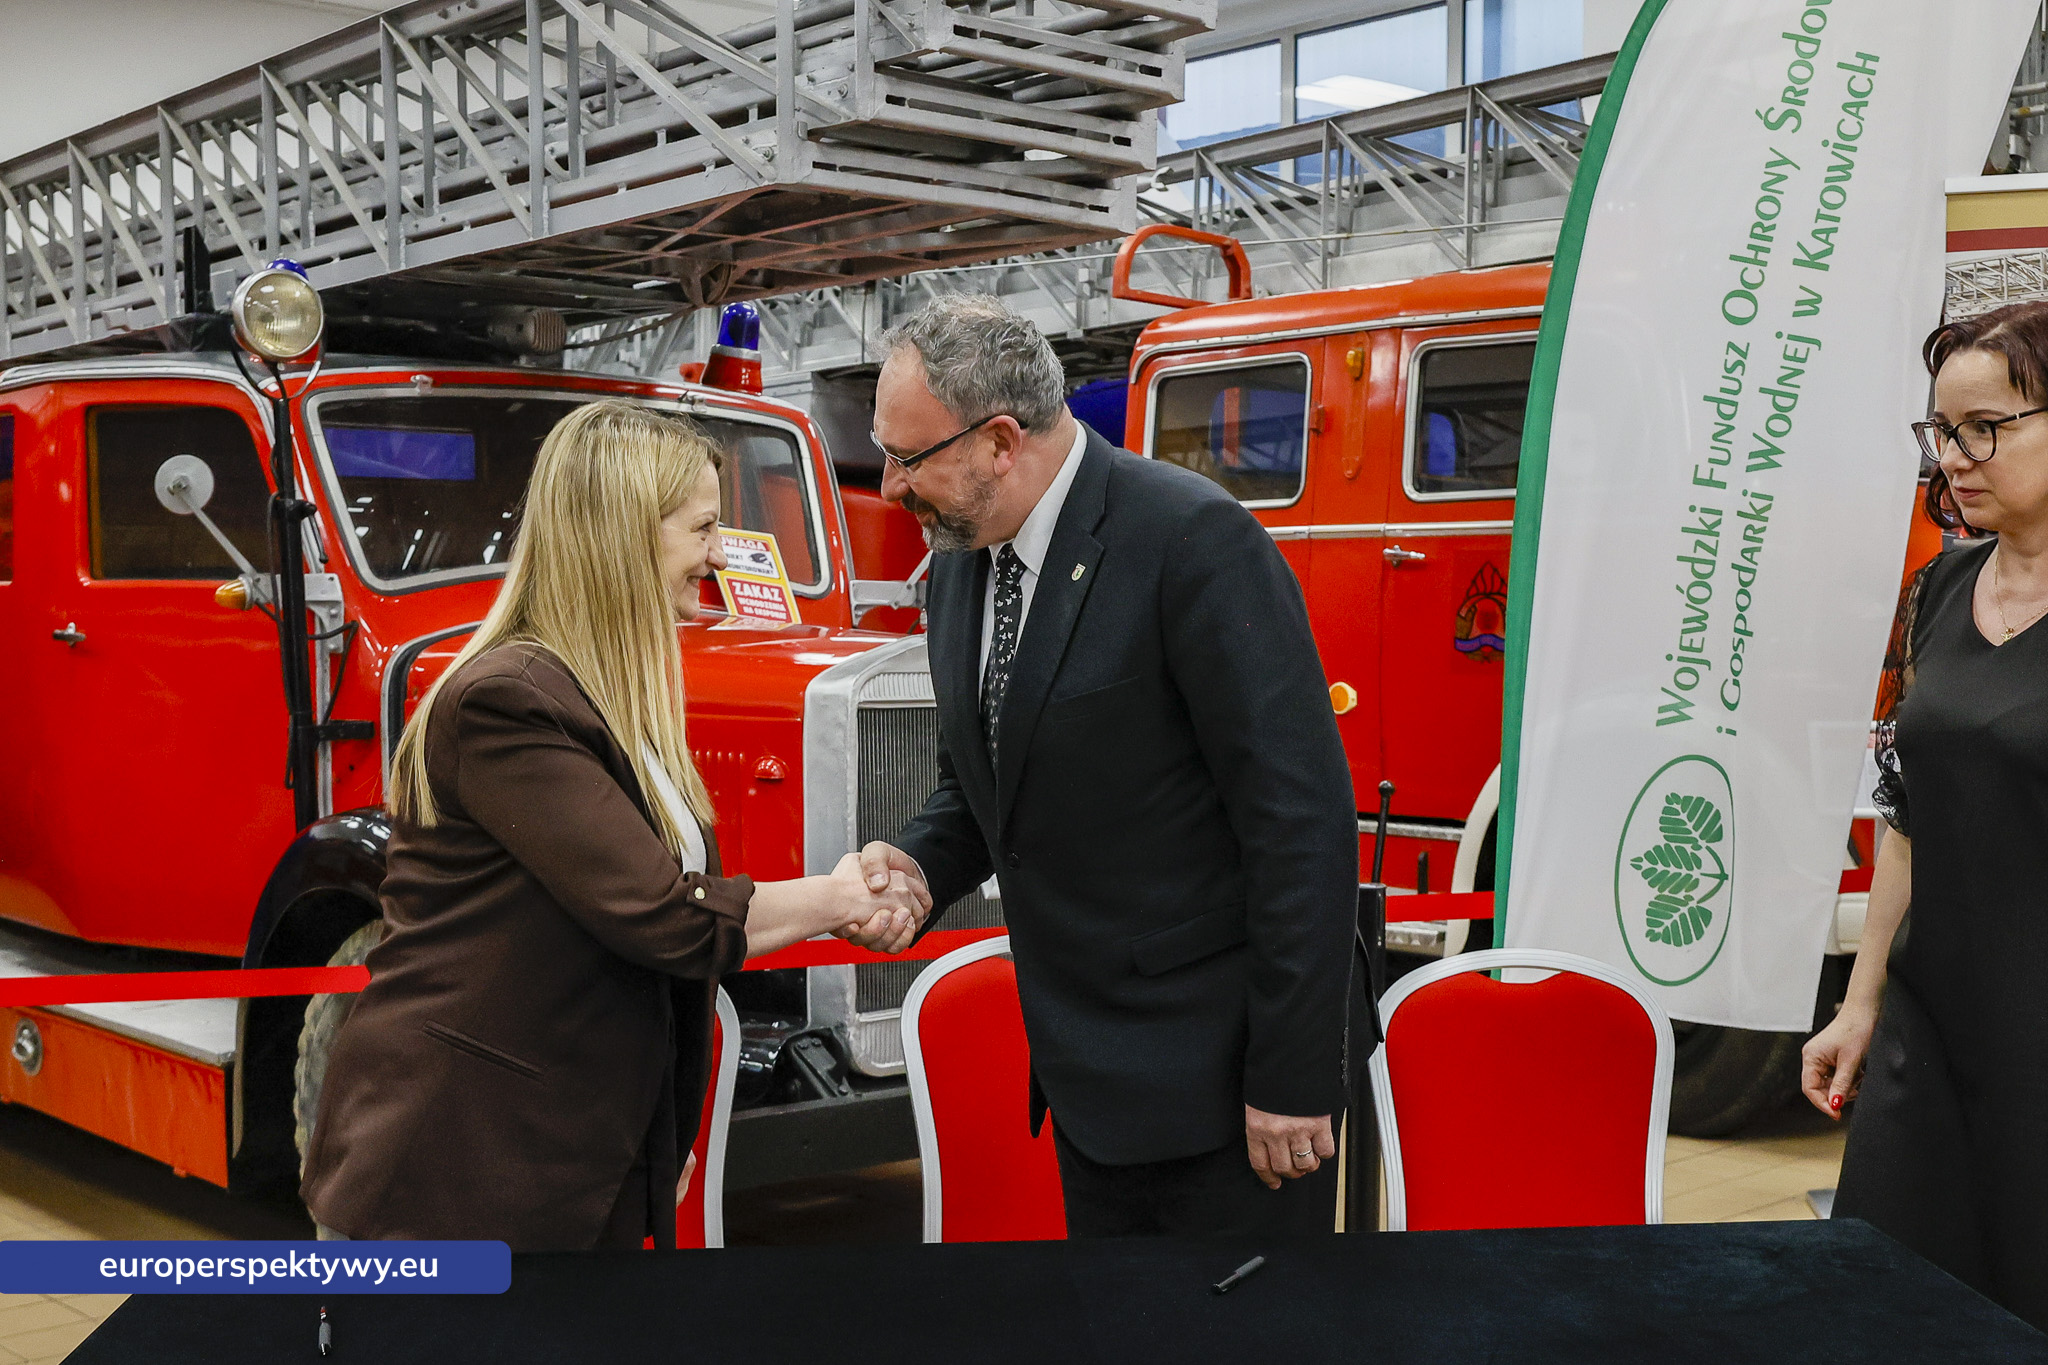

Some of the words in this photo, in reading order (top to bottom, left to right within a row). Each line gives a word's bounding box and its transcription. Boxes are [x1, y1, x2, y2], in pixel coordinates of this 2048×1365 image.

[1754, 0, 1834, 134] Środo
[1716, 725, 1737, 737] i
[1791, 285, 1823, 318] w
[731, 581, 783, 602] ZAKAZ
